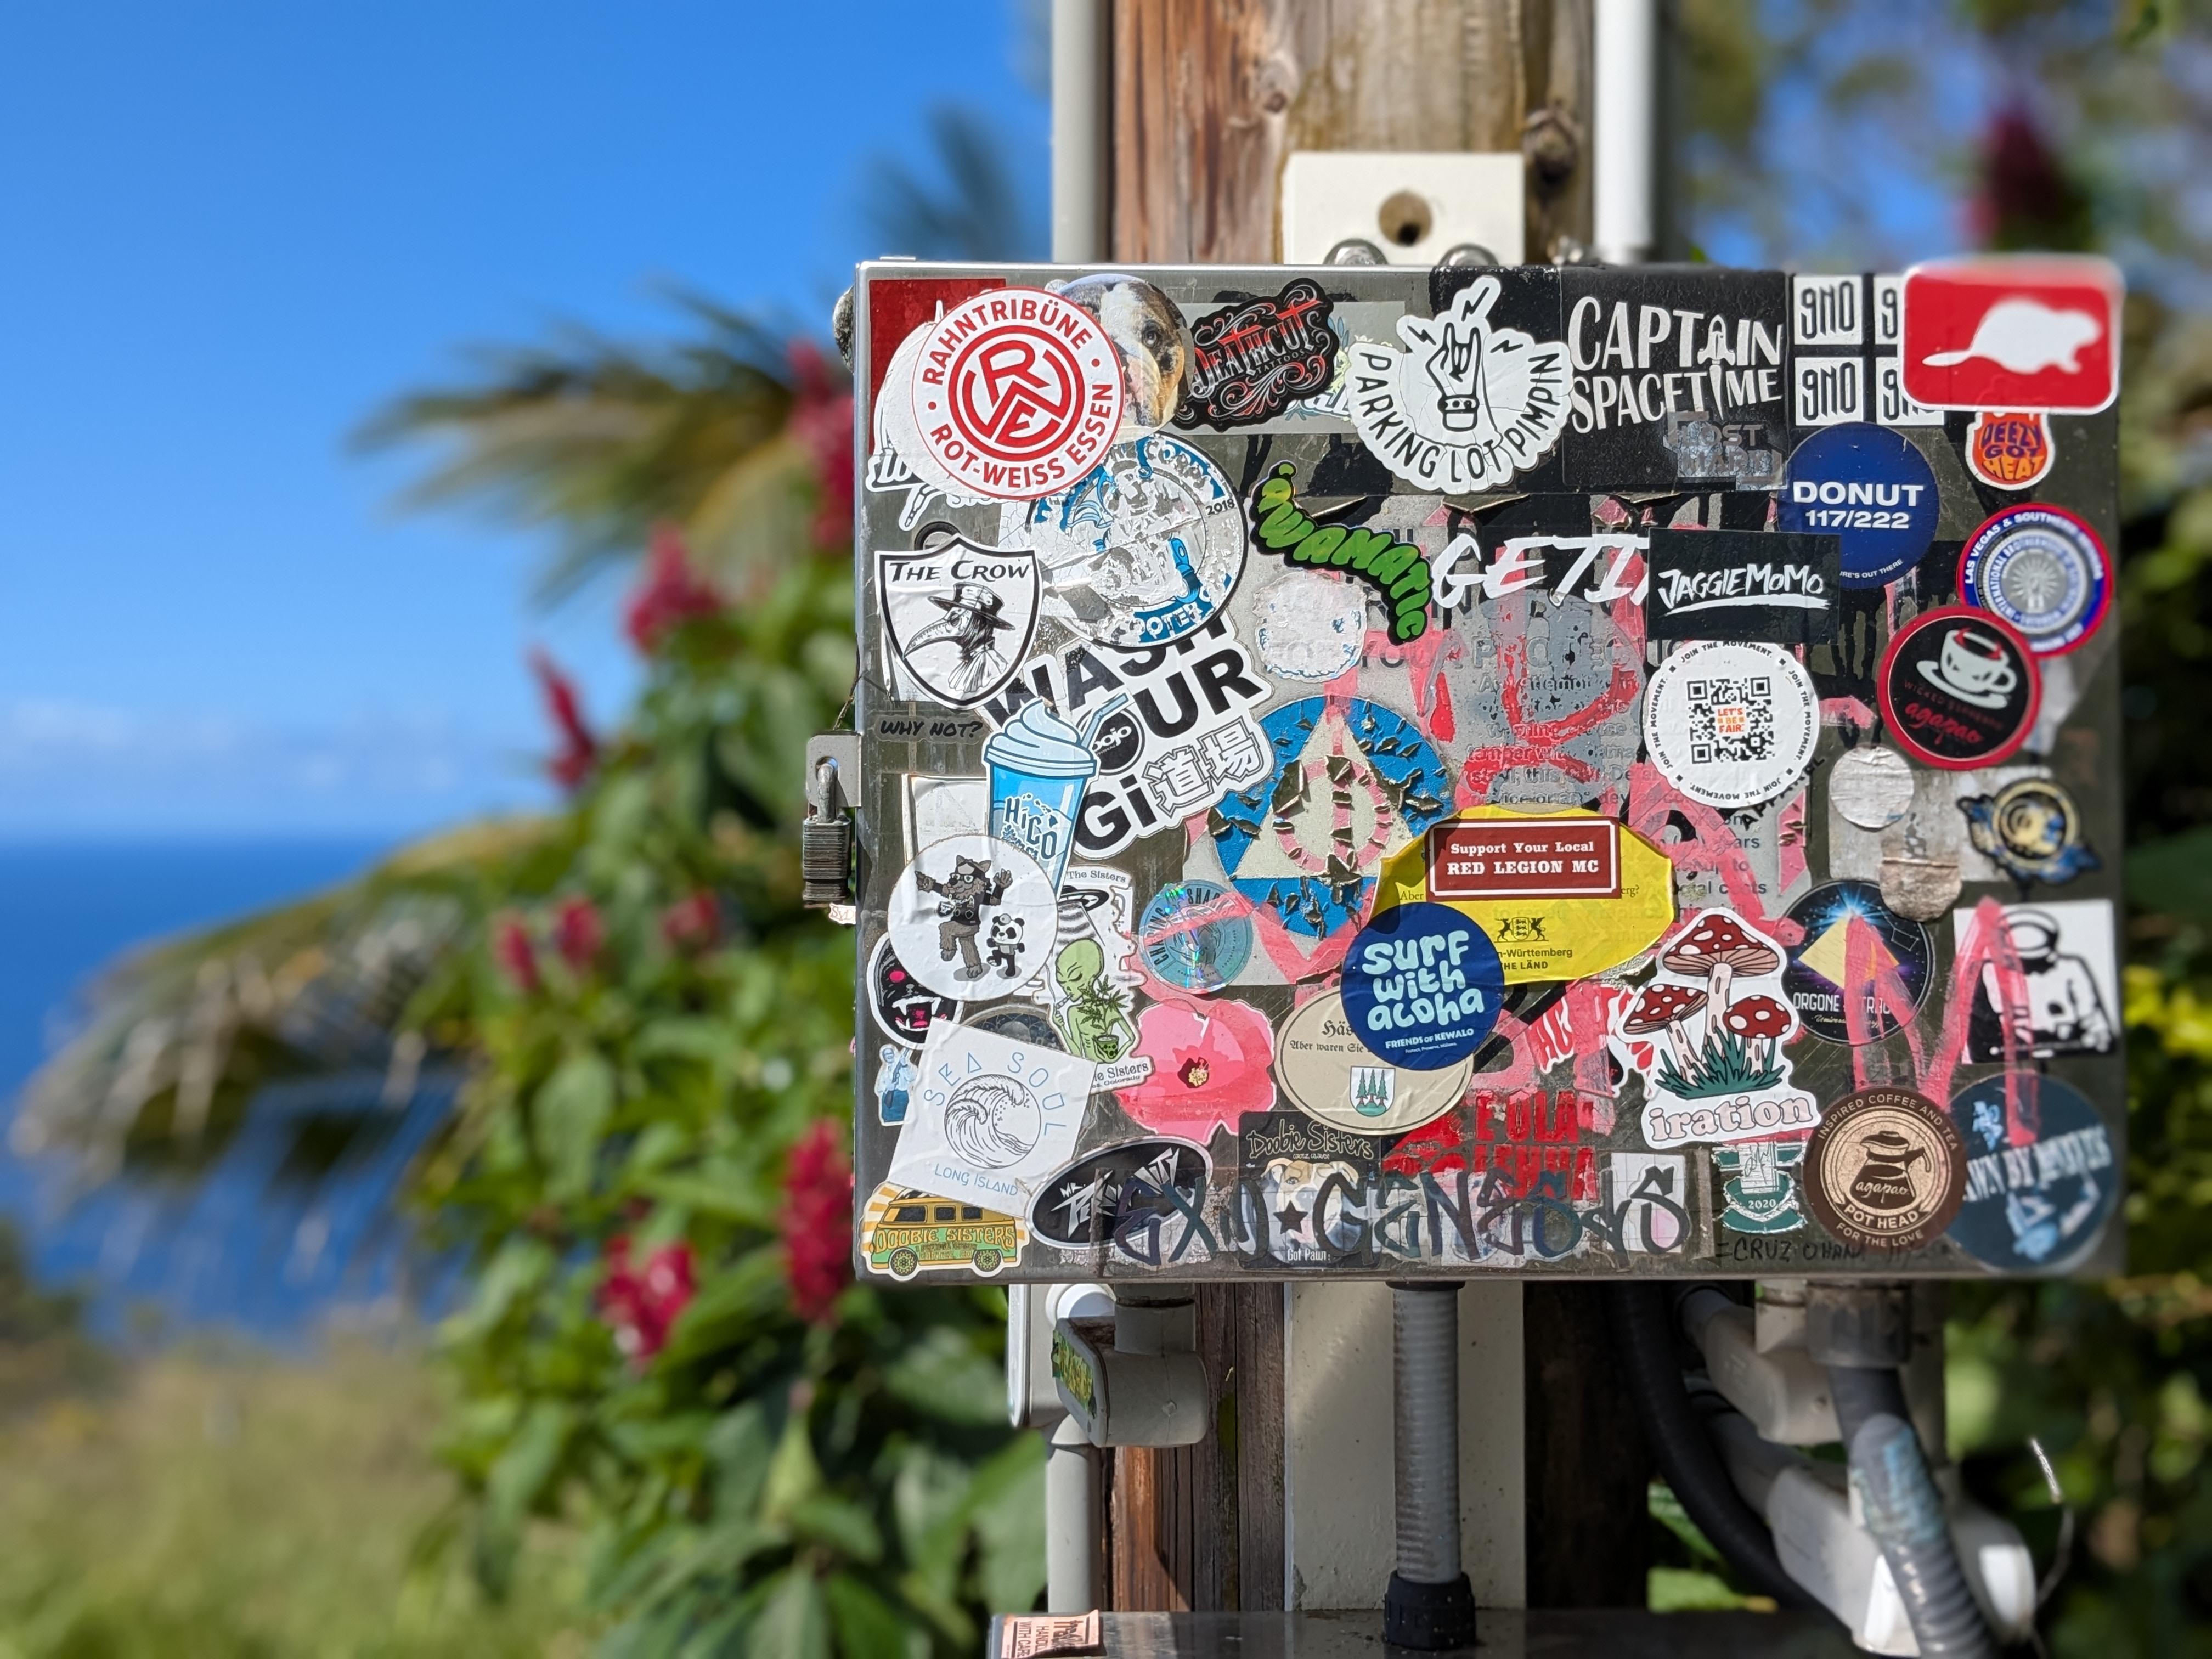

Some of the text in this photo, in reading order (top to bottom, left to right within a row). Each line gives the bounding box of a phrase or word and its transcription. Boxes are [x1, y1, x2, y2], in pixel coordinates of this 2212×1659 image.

[923, 298, 1092, 386] RAHNTRIBÜNE
[1568, 296, 1783, 371] CAPTAIN
[1256, 350, 1305, 374] TATTOOS
[1572, 363, 1782, 433] SPACETIME
[1356, 352, 1563, 483] PARKING LOT PIMPIN
[930, 424, 1065, 489] ROT-WEISS
[1066, 384, 1113, 466] ESSEN
[1980, 421, 2041, 448] DEEZY
[1984, 444, 2040, 459] GOT
[1982, 454, 2044, 480] HEAT
[1793, 481, 1925, 506] DONUT
[1206, 499, 1235, 515] 2018
[1805, 511, 1910, 529] 117/222
[2002, 518, 2012, 527] &
[1970, 524, 2000, 556] VEGAS
[889, 560, 1030, 582] THE CROW
[1878, 558, 1904, 574] THERE
[1965, 560, 1976, 584] LAS
[1681, 648, 1699, 663] JOIN
[1702, 642, 1718, 651] THE
[1651, 678, 1673, 769] JOIN THE MOVEMENT.
[1788, 670, 1811, 761] JOIN THE MOVEMENT.
[881, 720, 983, 738] WHY NOT?
[1141, 716, 1265, 817] 道場
[1690, 778, 1781, 800] JOIN THE MOVEMENT.
[1073, 774, 1158, 851] Gi
[1451, 841, 1594, 856] Support Your Local
[1066, 870, 1126, 883] The Sisters
[1447, 860, 1599, 875] RED LEGION MC
[1399, 884, 1640, 901] Aber erg?
[1497, 947, 1573, 959] n-Württemberg
[1520, 958, 1548, 970] LÄND
[1373, 960, 1466, 1003] with
[1793, 992, 1840, 1012] ORGONE
[1290, 1040, 1313, 1051] Aber
[1385, 1036, 1423, 1049] FRIENDS
[1435, 1028, 1474, 1041] KEWALO
[1107, 1063, 1148, 1078] Sisters
[923, 1052, 1066, 1135] SEA SOUL
[1649, 1097, 1812, 1141] iration
[1818, 1094, 1957, 1150] INSPIRED COFFEE AND TEA
[1246, 1119, 1374, 1159] Doobie Sisters
[935, 1163, 1018, 1196] LONG ISLAND
[1748, 1199, 1777, 1209] 2020
[1855, 1181, 1909, 1203] agapao
[1844, 1204, 1918, 1229] POT HEAD
[876, 1226, 1015, 1254] DOOBIE SISTERS
[1836, 1222, 1924, 1247] FOR THE LOVE
[1288, 1248, 1301, 1262] Got
[1734, 1237, 1791, 1262] CRUZ
